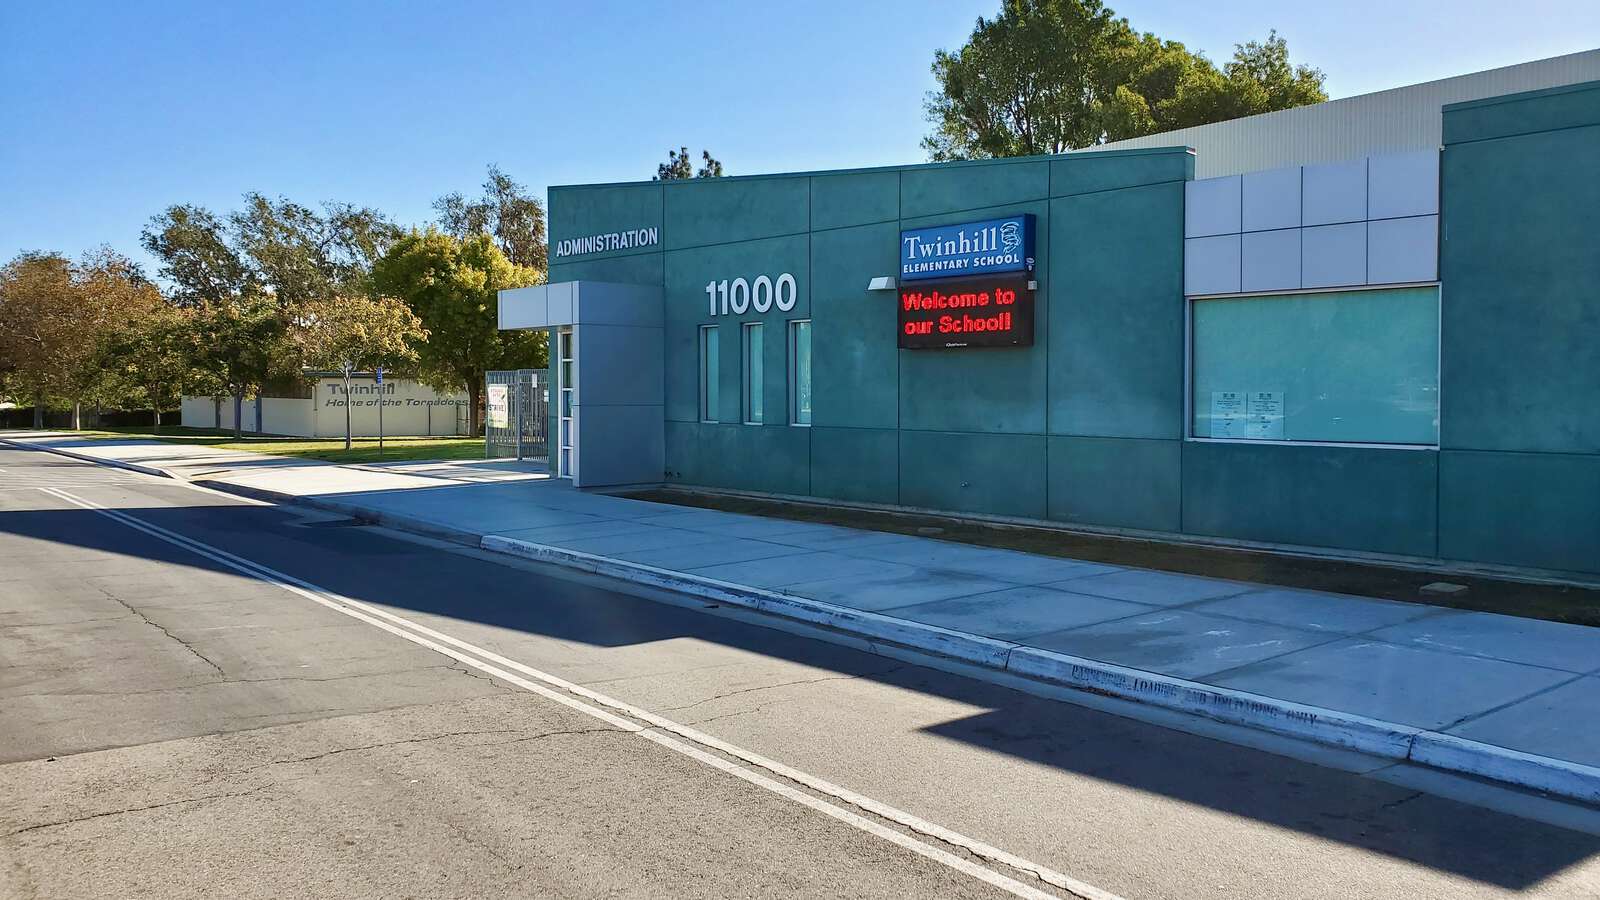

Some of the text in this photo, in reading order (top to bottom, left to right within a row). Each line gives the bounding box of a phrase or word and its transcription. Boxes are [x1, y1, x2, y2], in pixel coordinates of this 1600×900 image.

[556, 227, 659, 257] ADMINISTRATION
[904, 227, 998, 259] Twinhill
[903, 253, 1020, 274] ELEMENTARY SCHOOL
[705, 272, 797, 316] 11000
[902, 288, 1016, 311] Welcome to
[904, 320, 934, 335] our
[327, 383, 395, 395] Twinhill
[325, 399, 362, 407] Home
[366, 398, 380, 407] of
[382, 398, 402, 407] the
